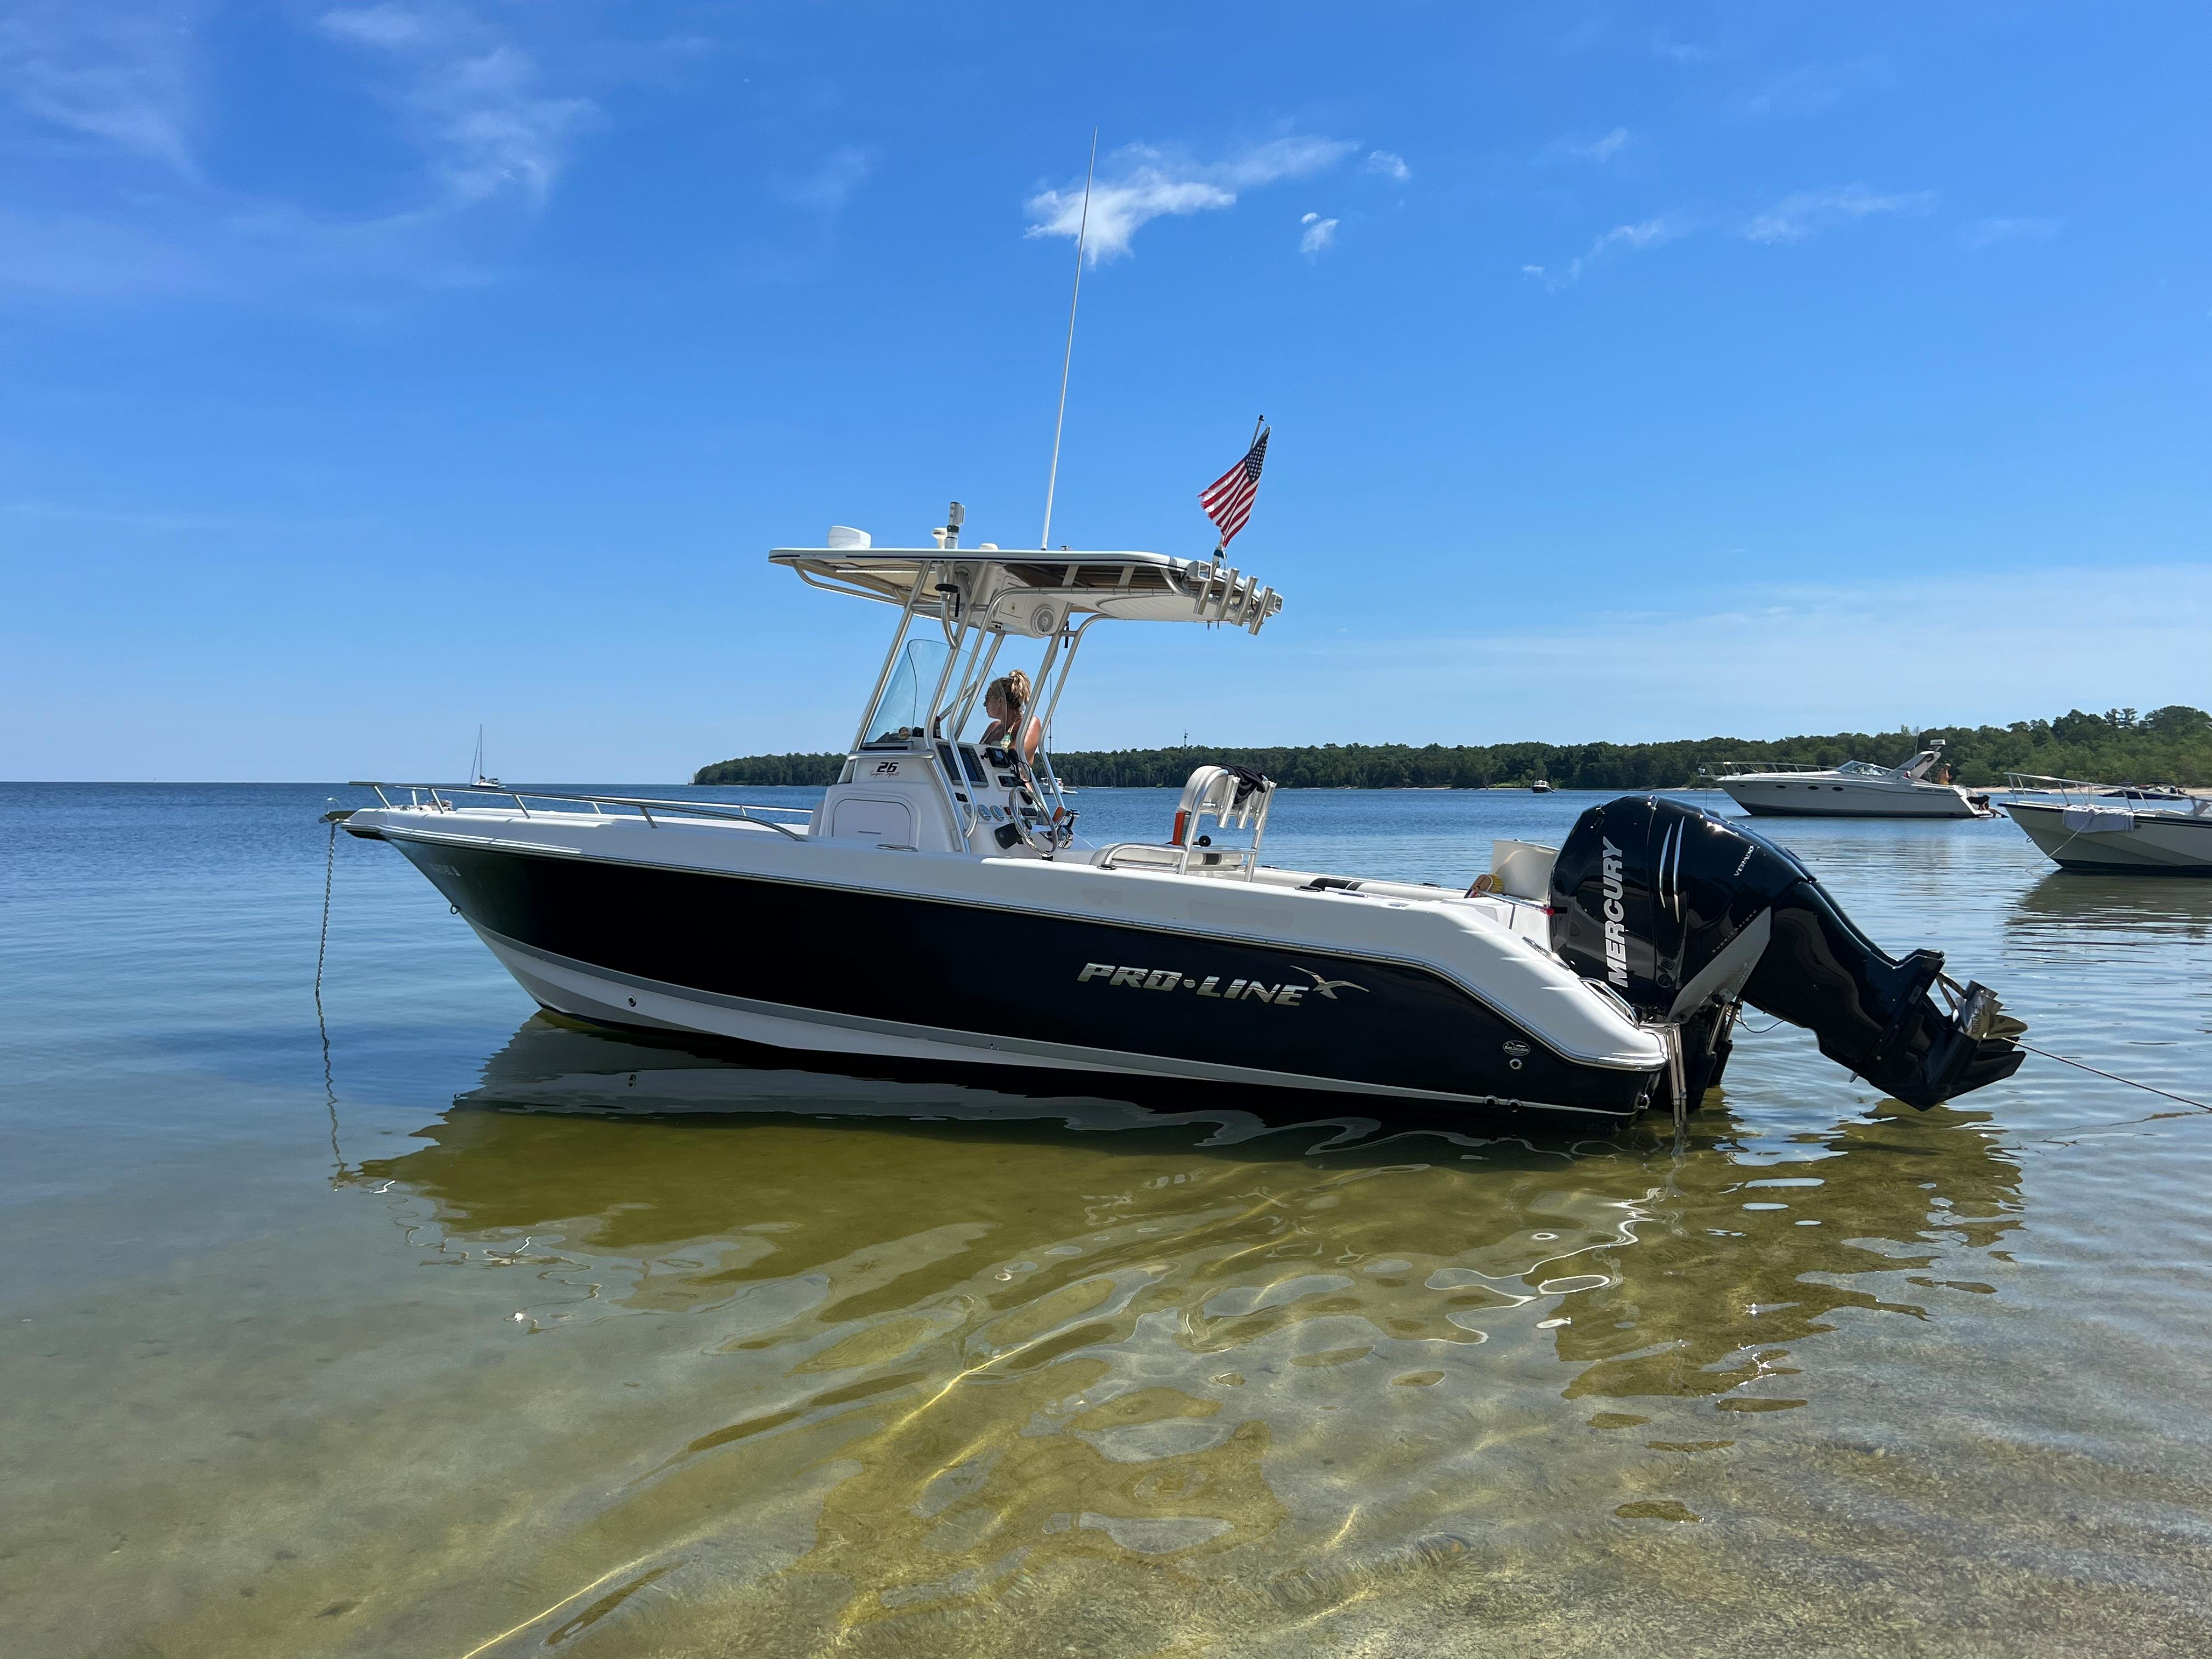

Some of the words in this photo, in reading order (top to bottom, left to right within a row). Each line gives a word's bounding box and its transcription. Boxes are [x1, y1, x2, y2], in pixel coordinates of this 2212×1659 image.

[876, 761, 899, 772] 26
[1734, 845, 1754, 876] VERADO
[1602, 836, 1628, 988] MERCURY
